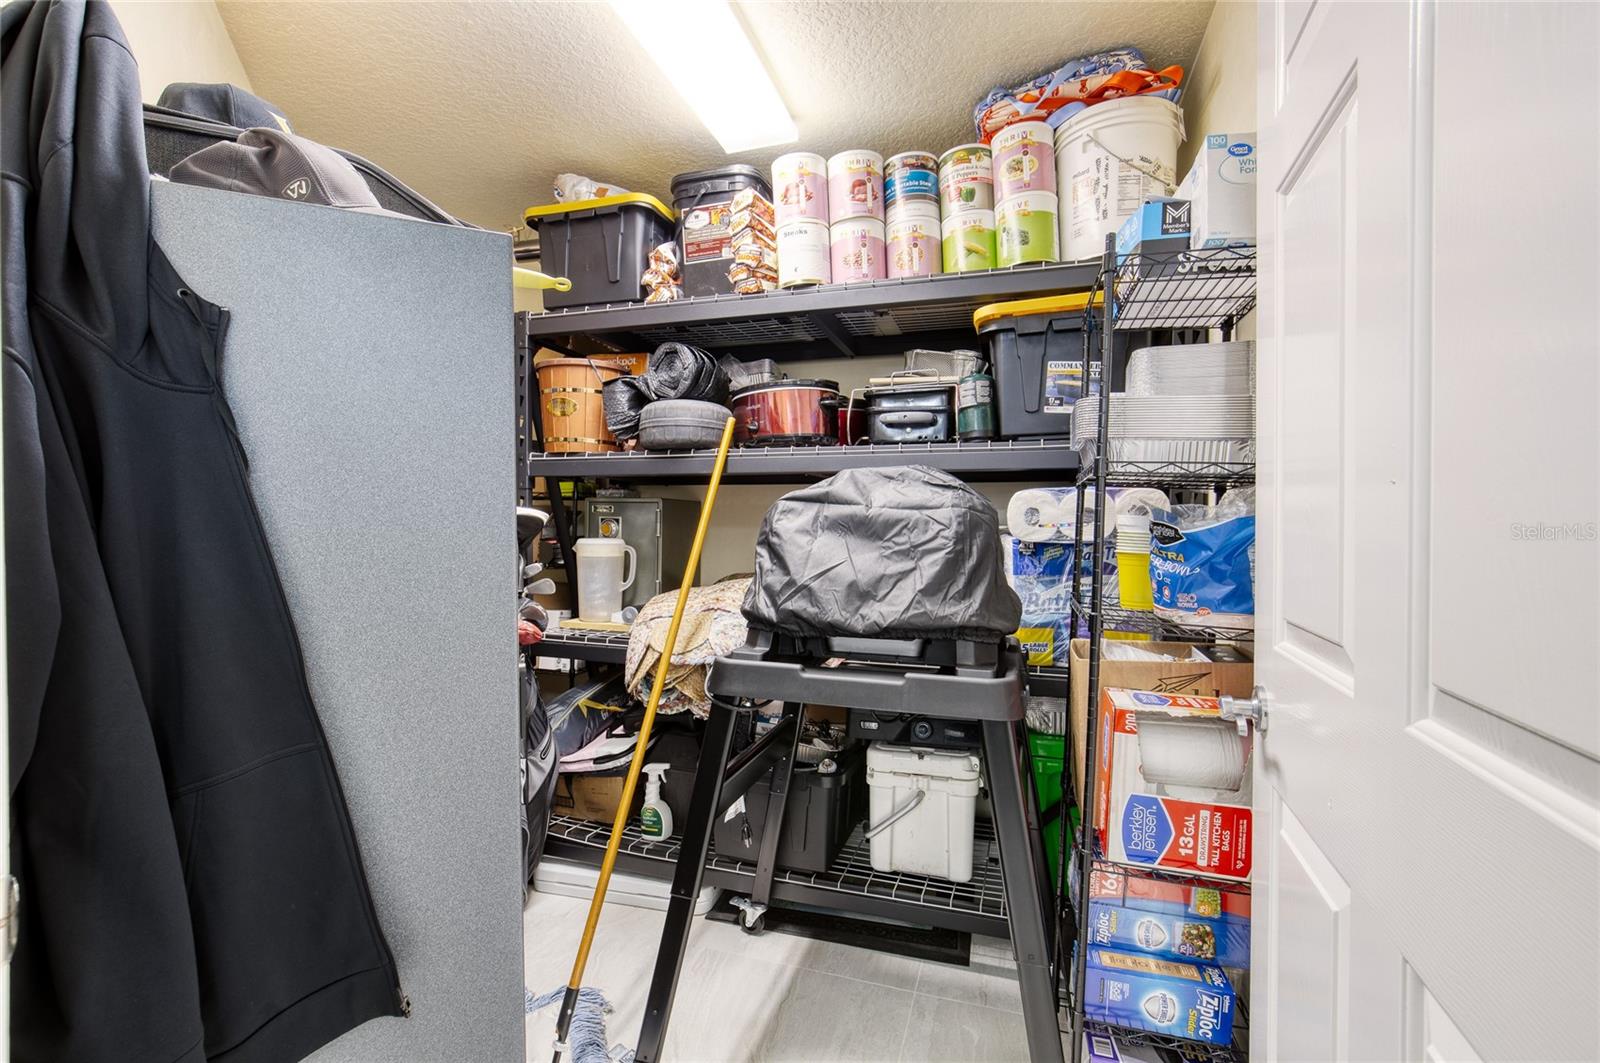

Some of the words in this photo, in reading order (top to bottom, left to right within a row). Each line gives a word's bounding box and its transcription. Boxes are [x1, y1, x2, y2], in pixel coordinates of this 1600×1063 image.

[1209, 136, 1225, 145] 100
[1049, 362, 1101, 370] COMMANER
[1127, 803, 1145, 851] berkley
[1183, 814, 1196, 837] GAL
[1212, 811, 1223, 846] KITCHEN
[1178, 836, 1194, 857] 13
[1198, 815, 1210, 862] DRAWSTRING
[1221, 830, 1231, 852] BAGS
[1210, 847, 1221, 867] TALL
[1096, 912, 1112, 944] Ziploc
[1159, 992, 1169, 1008] POWER
[1157, 1008, 1167, 1024] SHIELD
[1188, 1008, 1197, 1036] Slider
[1196, 994, 1219, 1039] Ziploc
